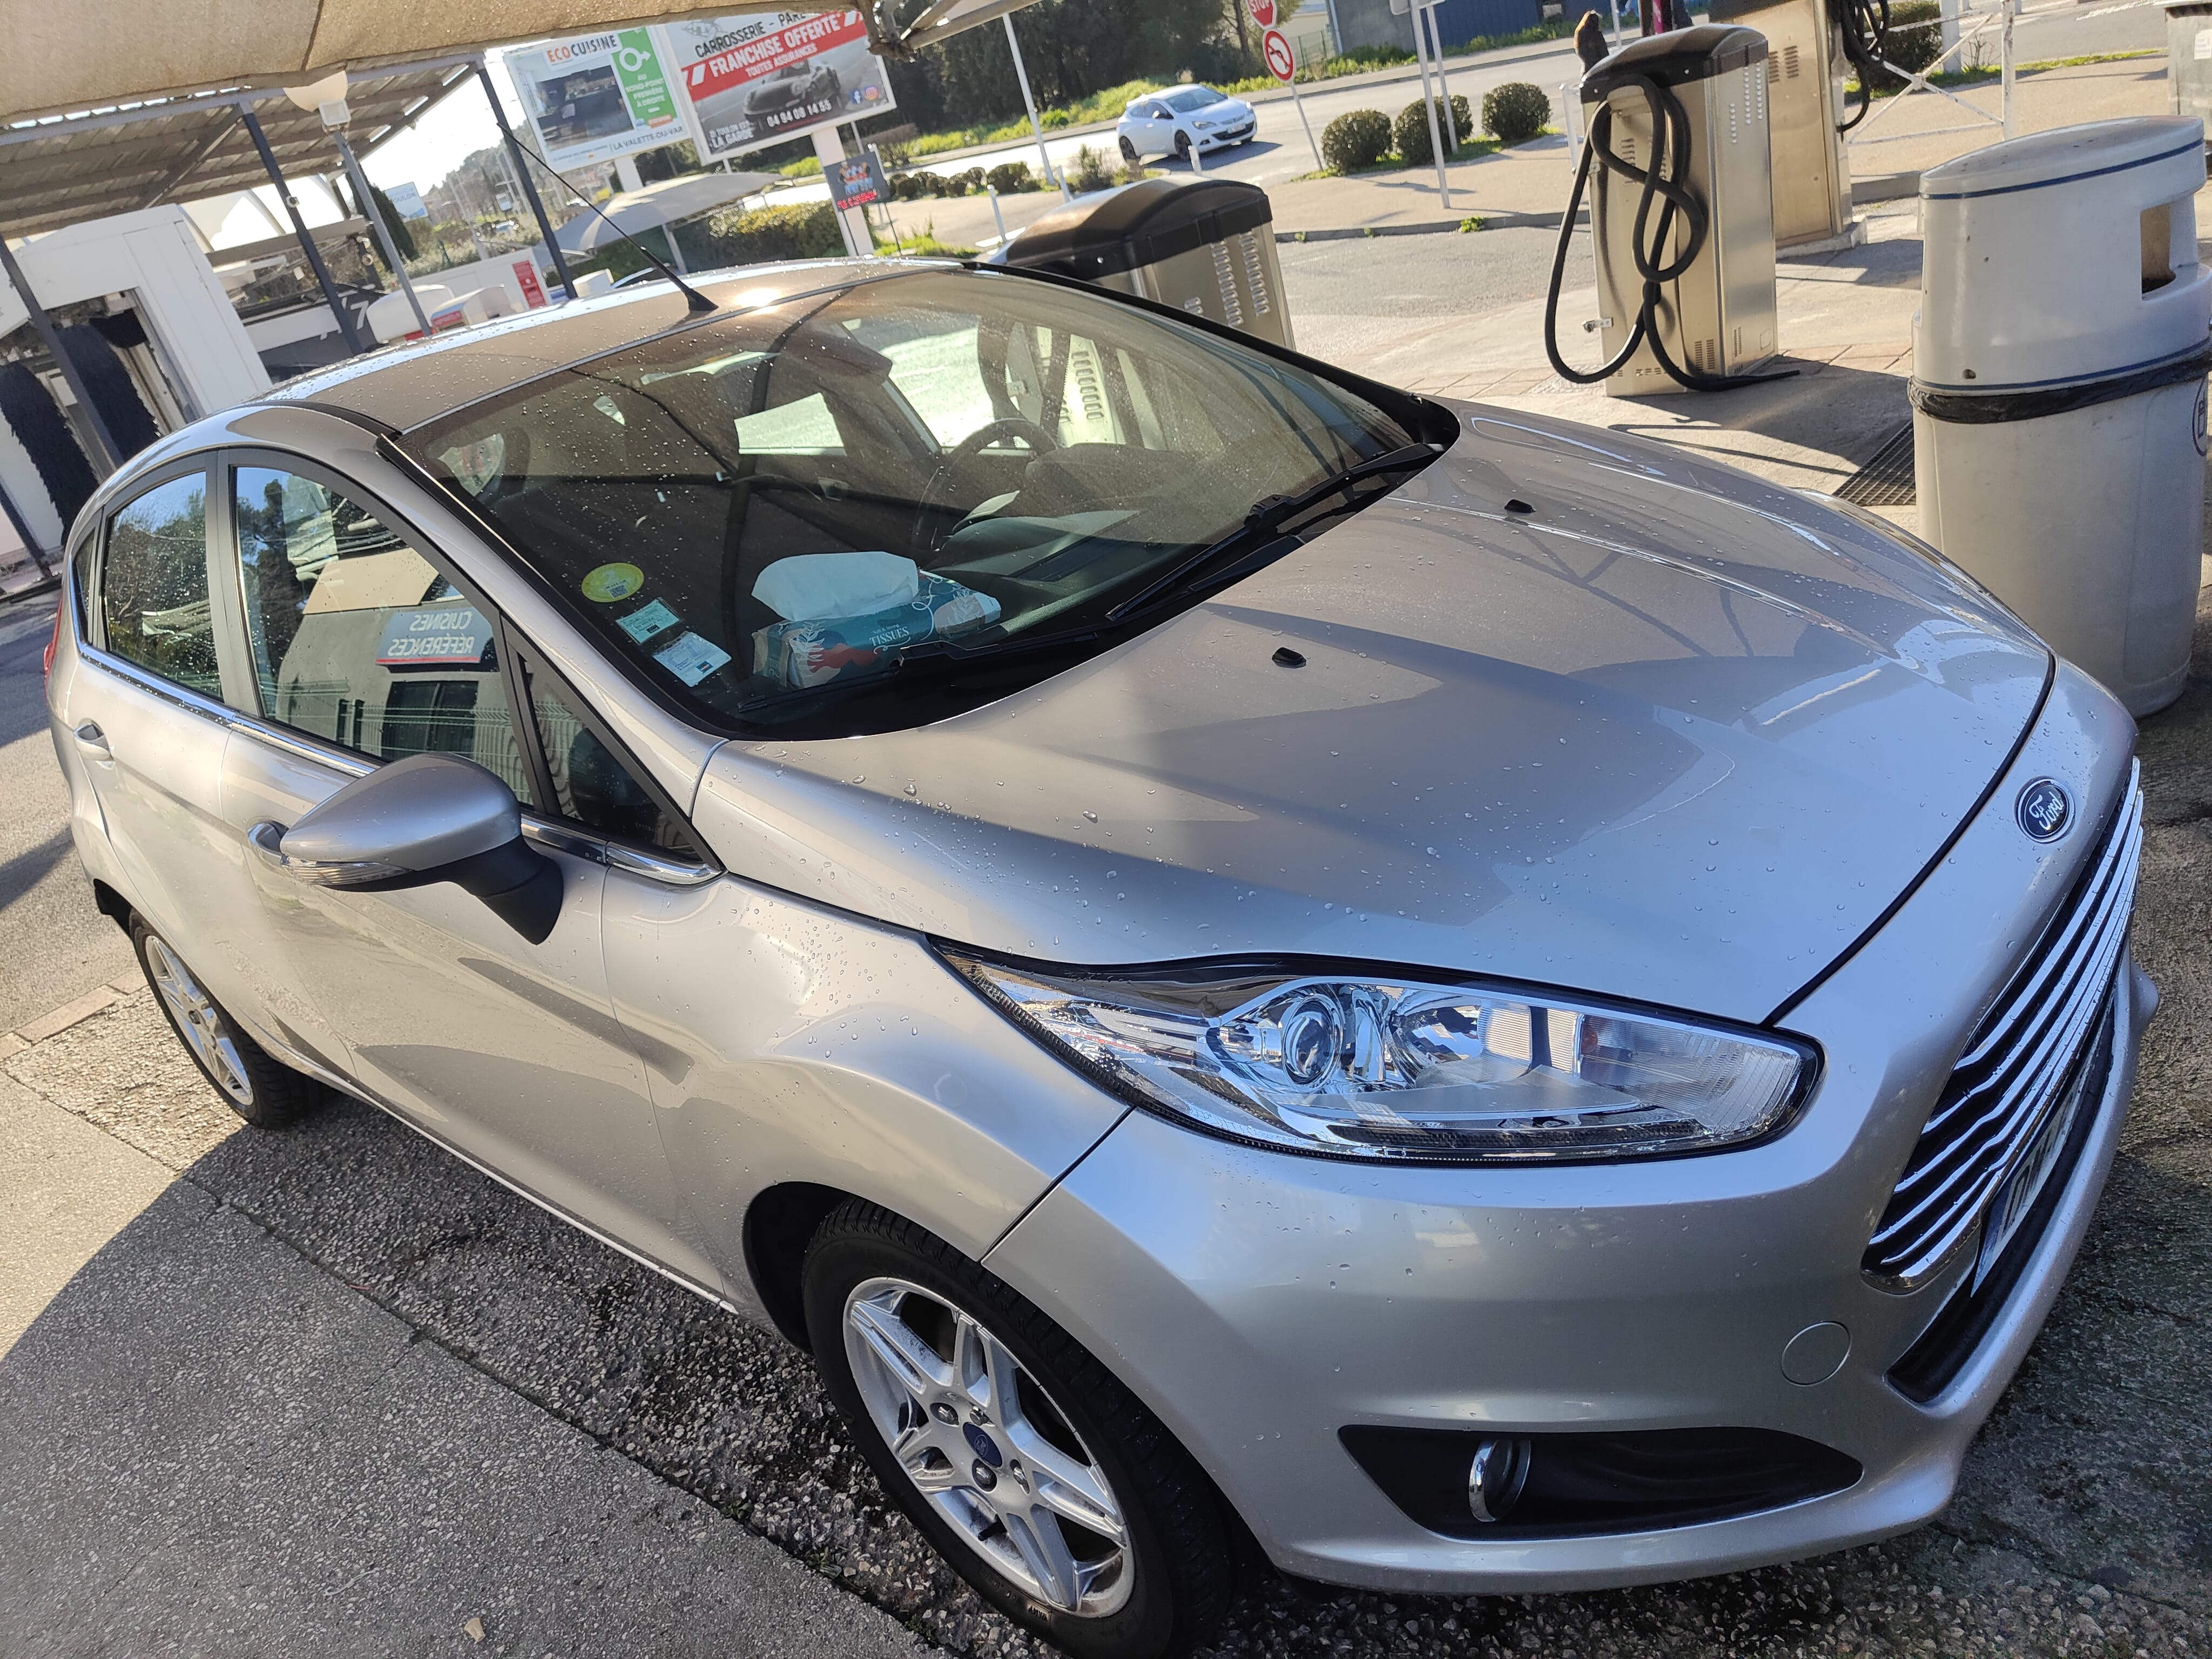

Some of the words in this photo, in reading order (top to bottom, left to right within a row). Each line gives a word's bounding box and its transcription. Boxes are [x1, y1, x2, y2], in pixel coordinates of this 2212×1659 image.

[695, 22, 765, 57] CARROSSERIE
[709, 36, 784, 78] FRANCHISE
[745, 60, 773, 77] TOUTES
[773, 43, 818, 67] ASSURANCES
[869, 626, 909, 646] TISSUES
[2028, 791, 2065, 831] Ford
